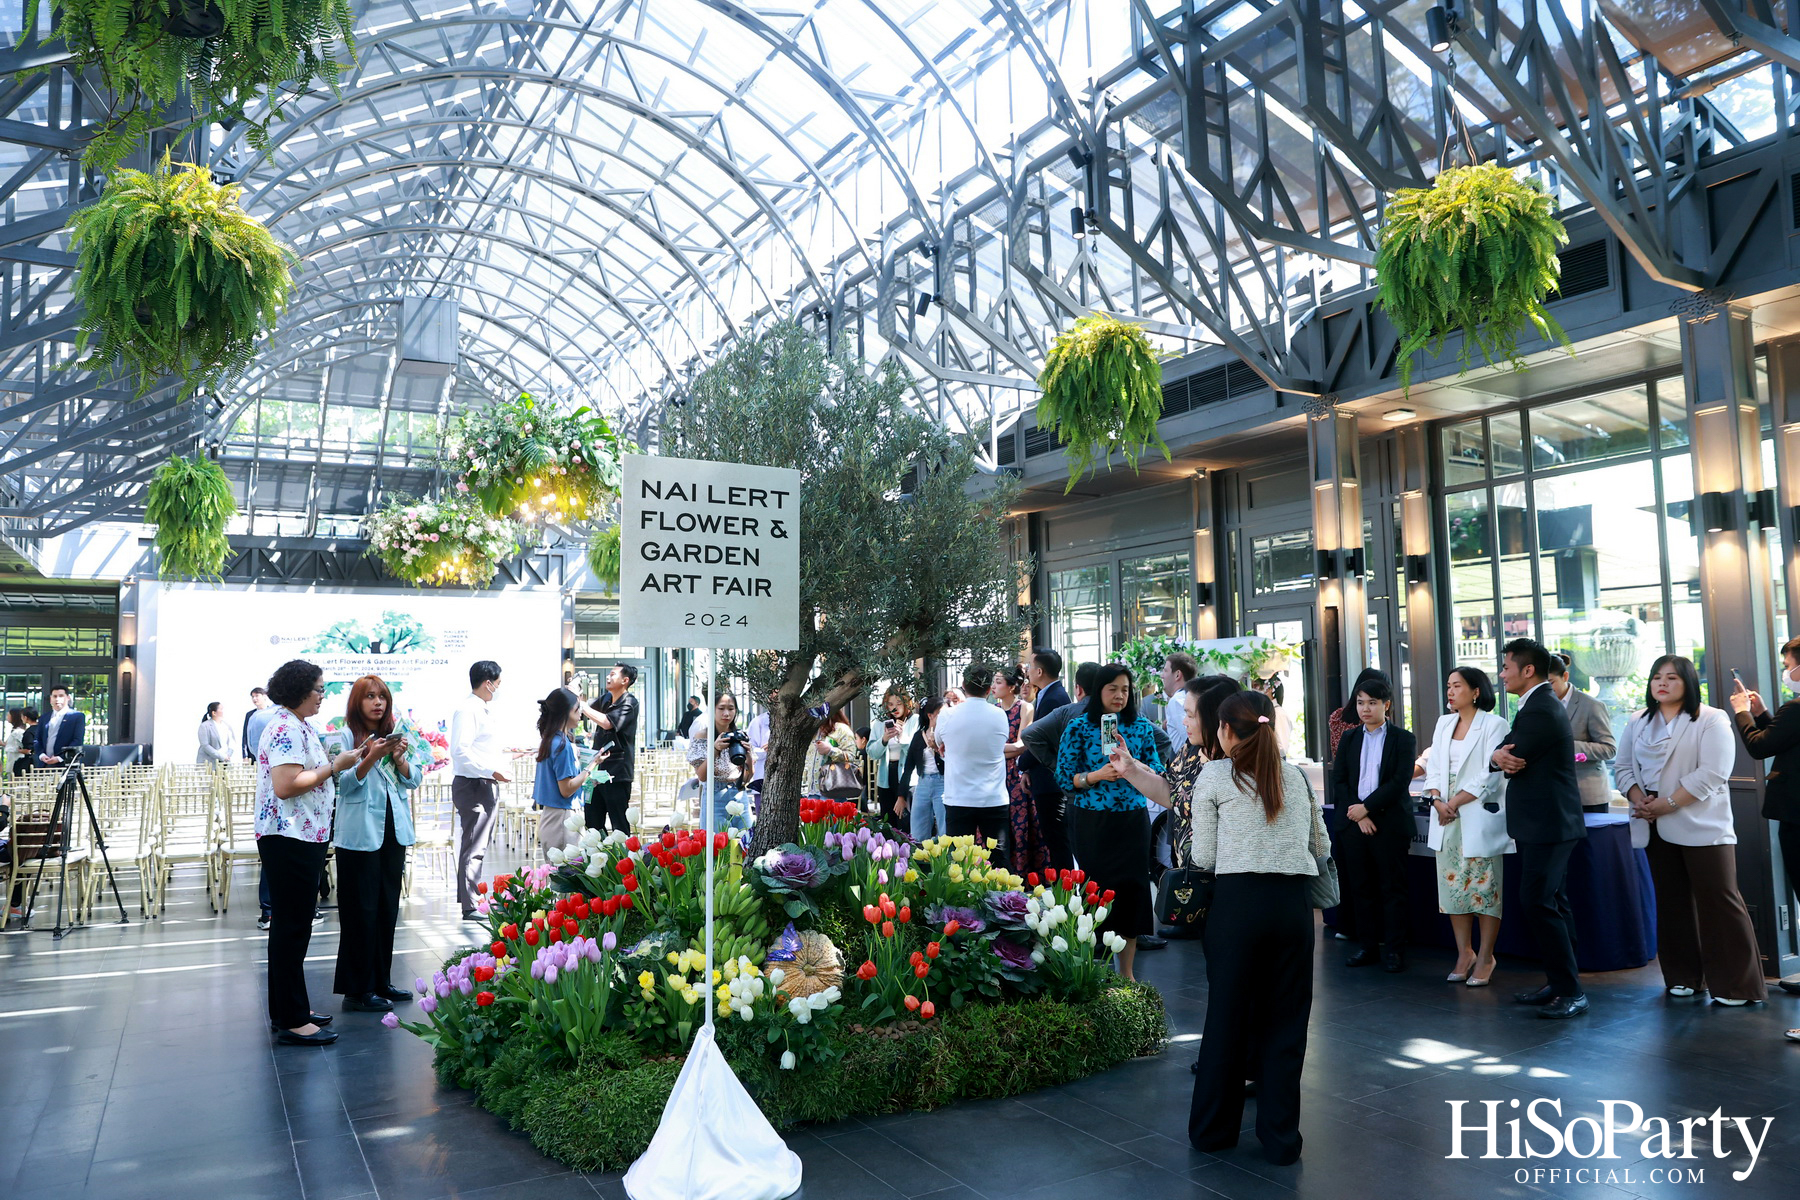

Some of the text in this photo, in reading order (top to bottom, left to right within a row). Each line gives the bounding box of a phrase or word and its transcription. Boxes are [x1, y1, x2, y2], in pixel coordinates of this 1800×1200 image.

[641, 480, 790, 509] NAI LERT
[641, 510, 789, 539] FLOWER &
[640, 541, 760, 567] GARDEN
[640, 573, 772, 597] ART FAIR
[684, 613, 748, 627] 2024
